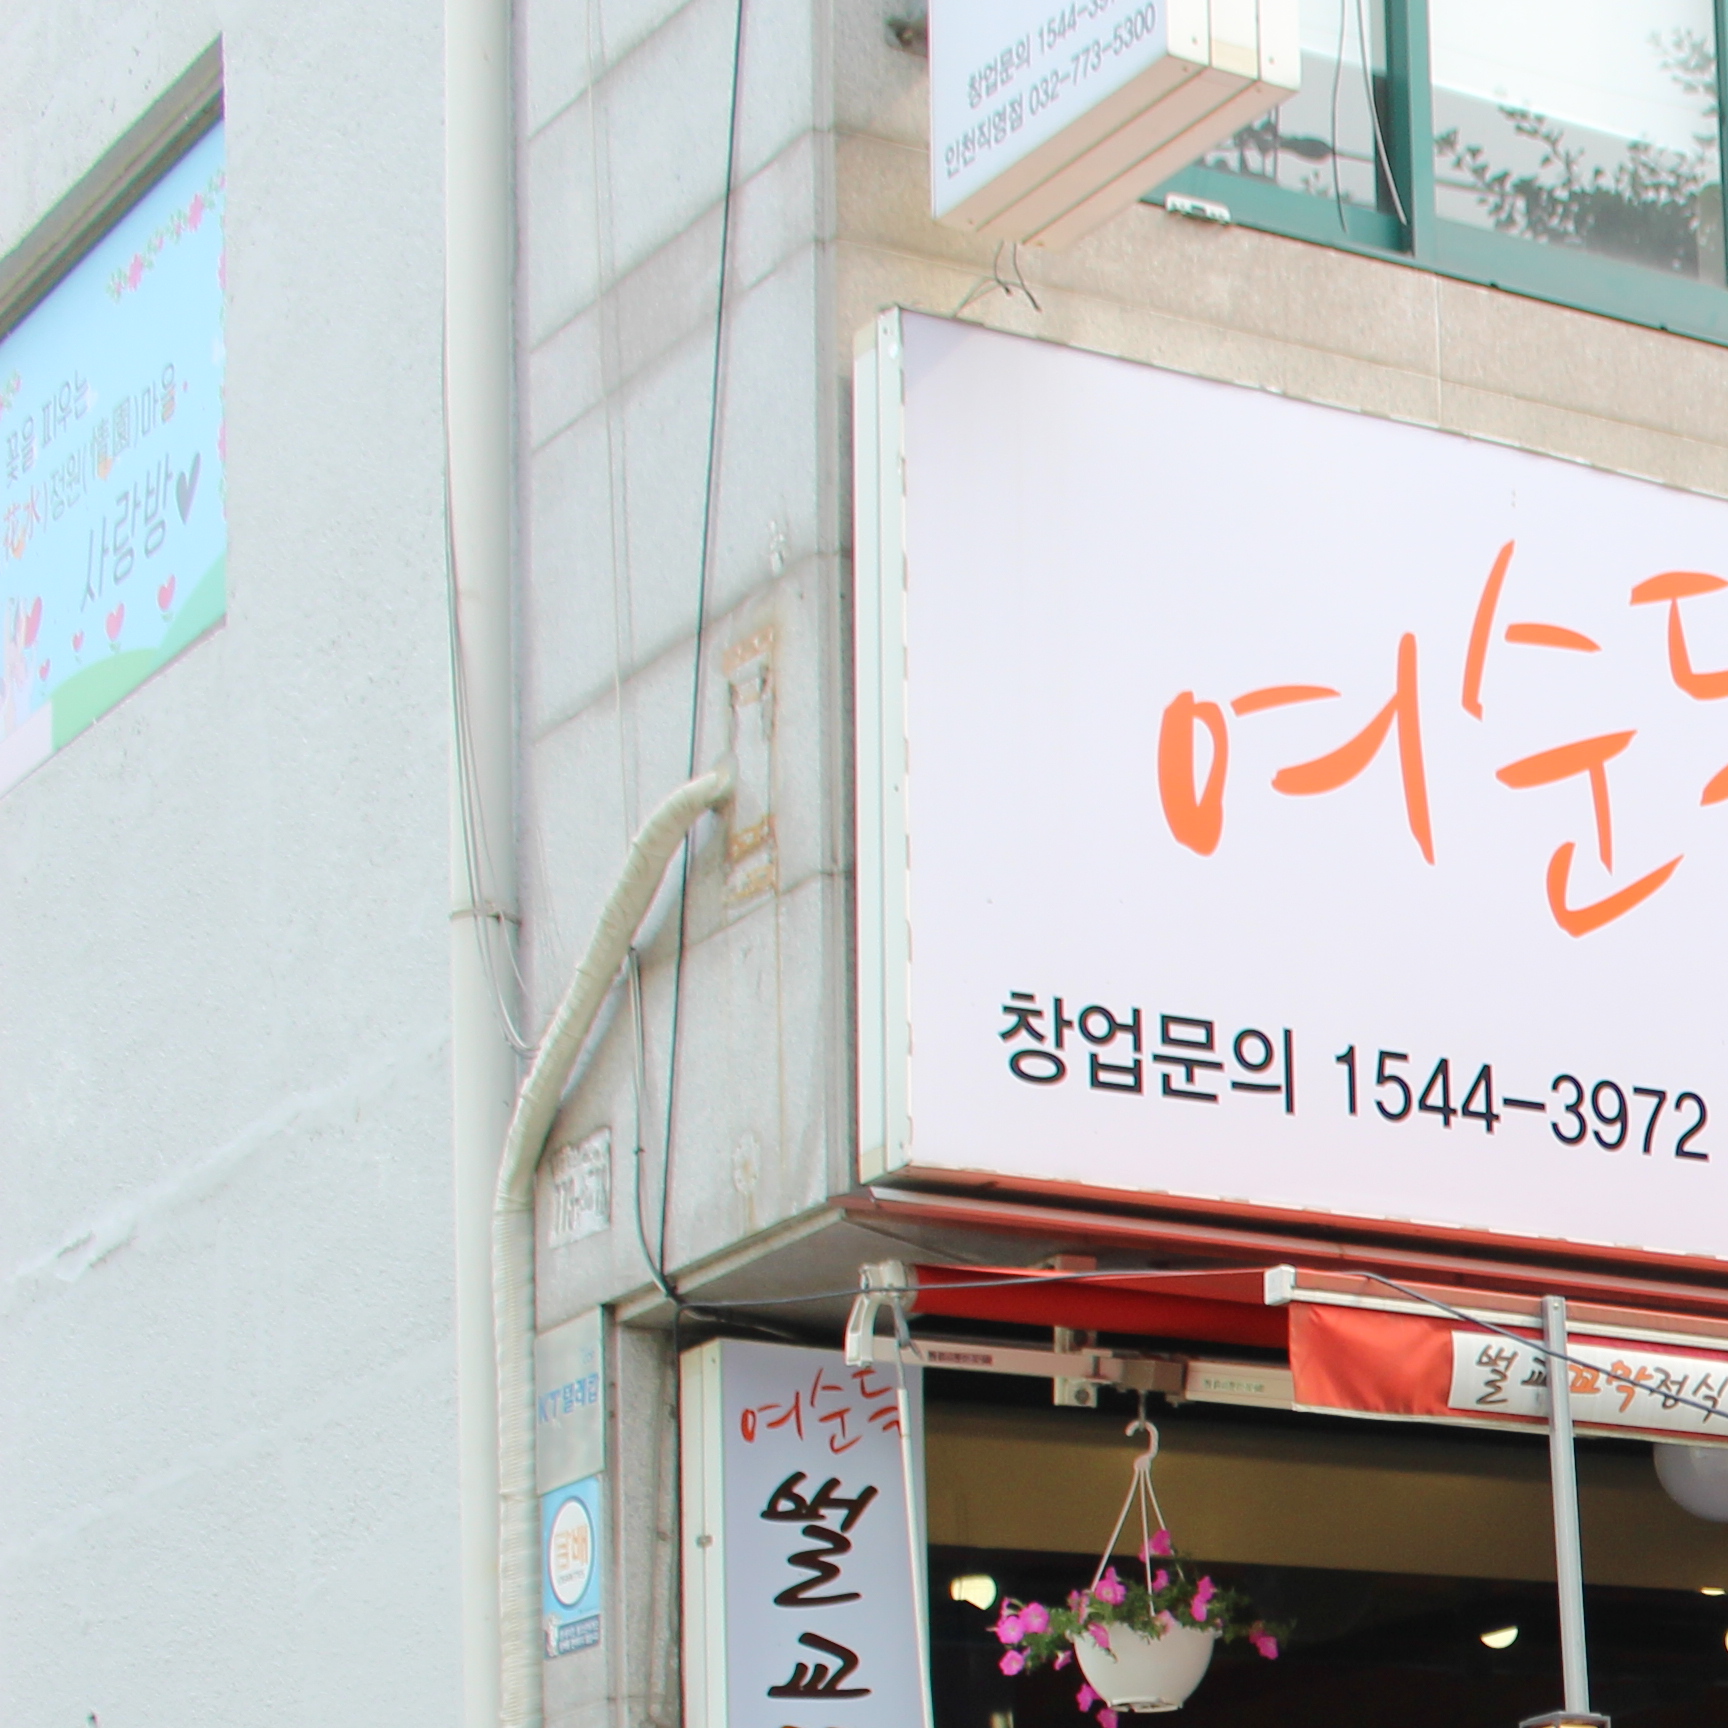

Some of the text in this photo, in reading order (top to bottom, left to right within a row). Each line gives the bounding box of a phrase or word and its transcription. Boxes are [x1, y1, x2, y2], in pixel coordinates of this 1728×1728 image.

[945, 3, 1157, 179] 인천직영점 032-773-5300
[967, 34, 1031, 109] 창업문의
[80, 453, 173, 612] 사랑방
[998, 989, 1712, 1164] 창업문의 1544-3972
